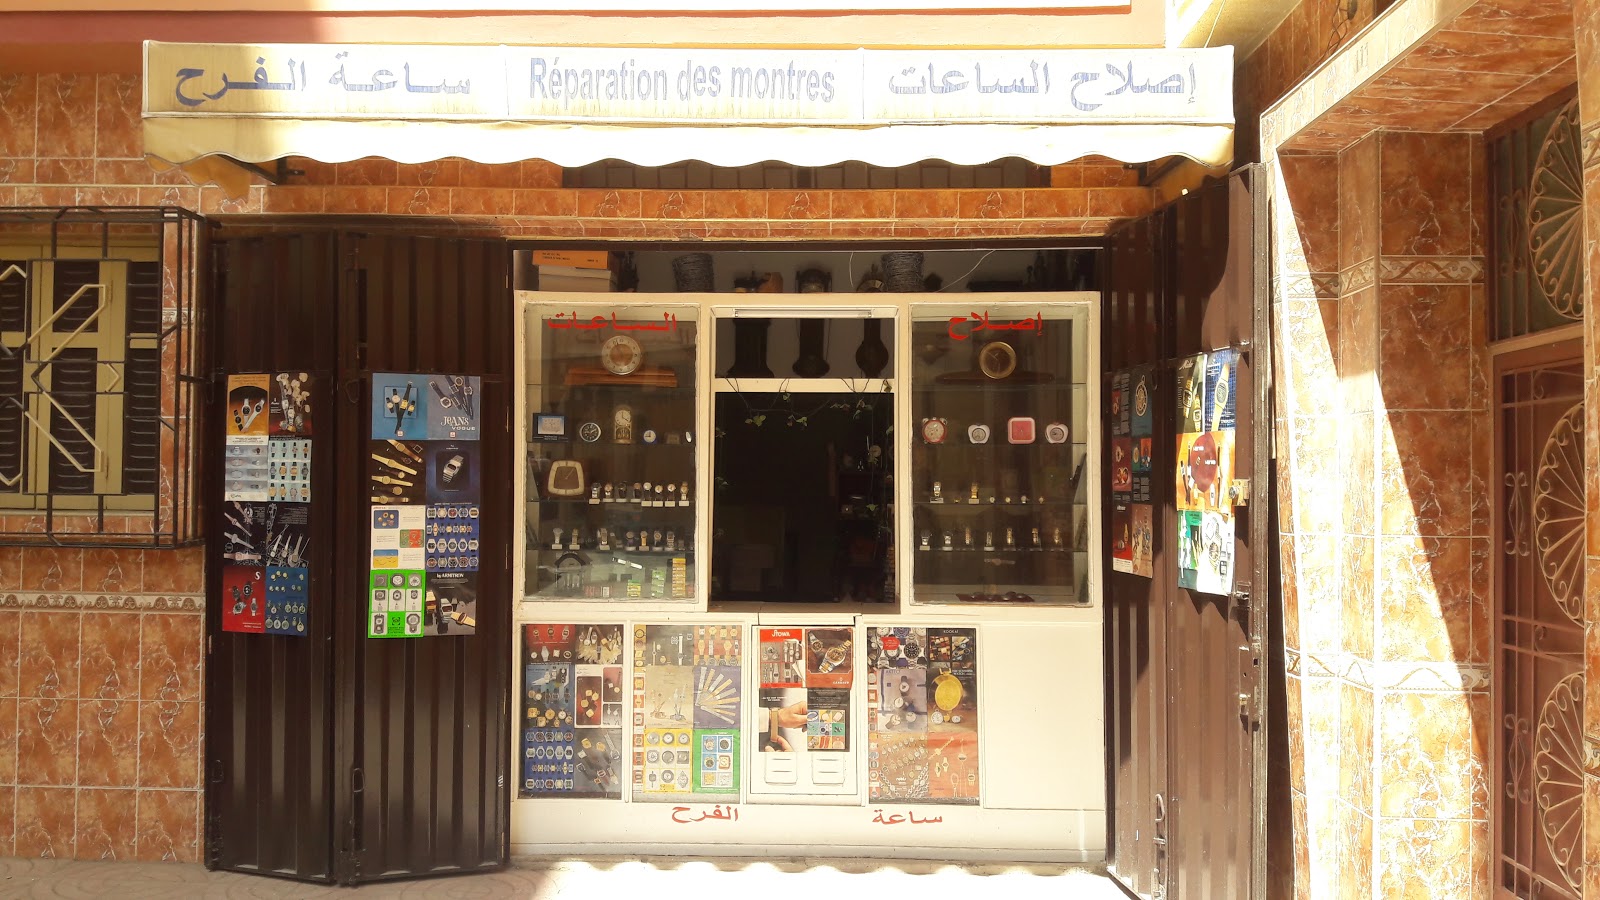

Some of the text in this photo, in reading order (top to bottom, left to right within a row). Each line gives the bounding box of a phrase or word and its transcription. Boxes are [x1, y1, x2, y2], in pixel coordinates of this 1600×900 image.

[175, 51, 471, 107] ساعة الفرح
[529, 57, 836, 111] Réparation des montres
[889, 60, 1198, 112] إصلاح الساعات
[547, 311, 677, 332] الساعات
[948, 310, 1043, 341] إصلاح
[254, 571, 261, 581] S
[671, 805, 943, 825] ساعة الفرح
